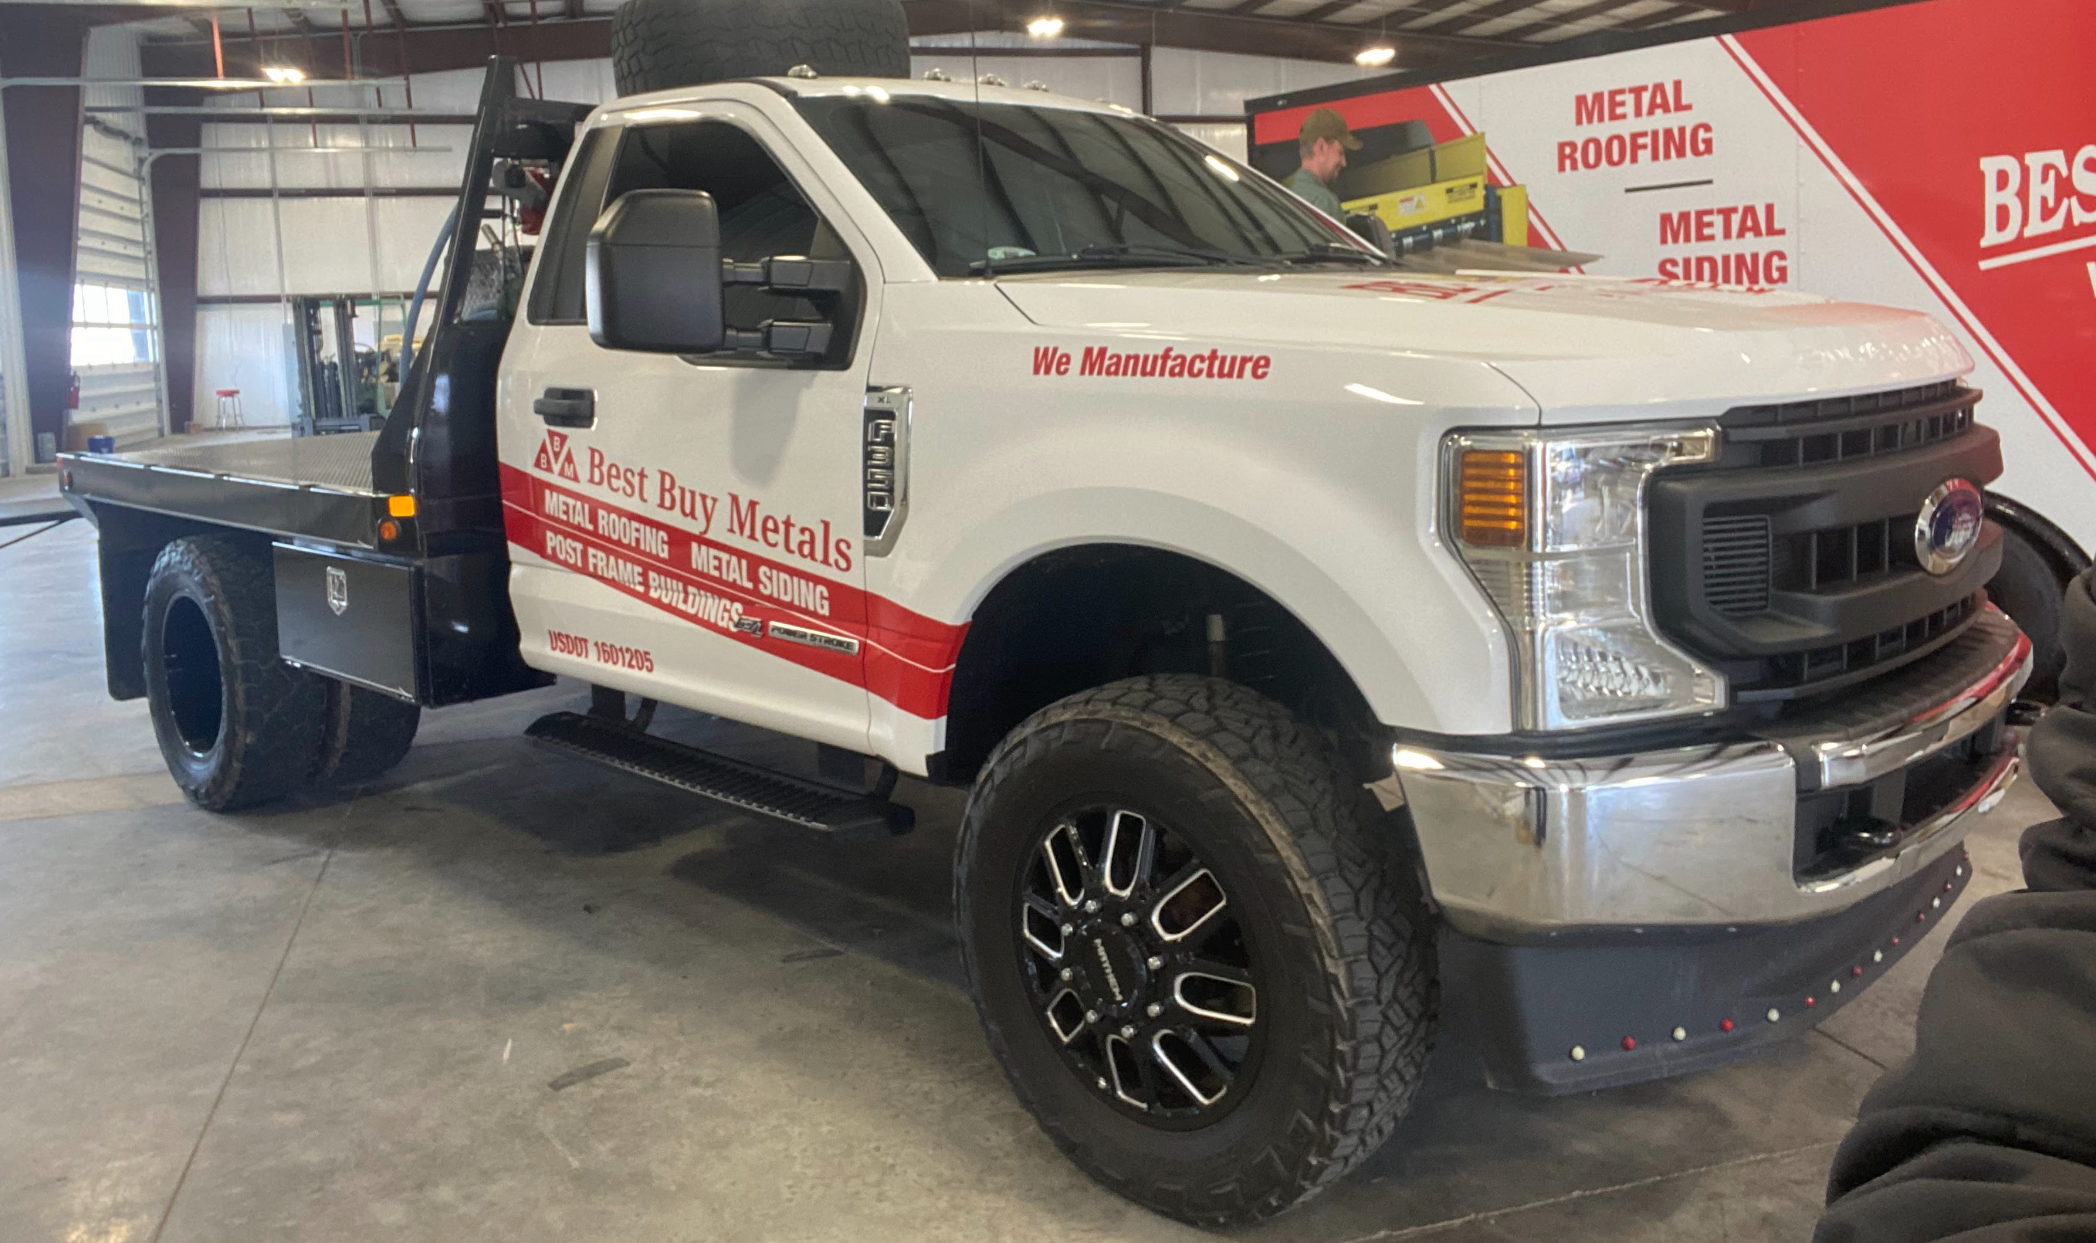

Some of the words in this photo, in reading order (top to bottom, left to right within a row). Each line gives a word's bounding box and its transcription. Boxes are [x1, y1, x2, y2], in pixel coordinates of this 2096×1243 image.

[1575, 79, 1693, 126] METAL
[1557, 122, 1714, 172] ROOFING
[1659, 203, 1786, 245] METAL
[1658, 249, 1788, 287] SIDING
[1033, 346, 1071, 376] We
[1079, 346, 1271, 379] Manufacture
[588, 446, 648, 503] Best
[657, 469, 719, 535] Buy
[727, 492, 852, 573] Metals
[544, 489, 594, 531] METAL
[598, 508, 669, 560] ROOFING
[691, 541, 753, 589] METAL
[758, 565, 830, 617] SIDING
[545, 530, 583, 568] POST
[588, 546, 645, 593] FRAME
[648, 570, 744, 632] BUILDINGS
[548, 628, 589, 659] USDOT
[594, 641, 654, 673] 1601205
[809, 633, 855, 651] STROKE
